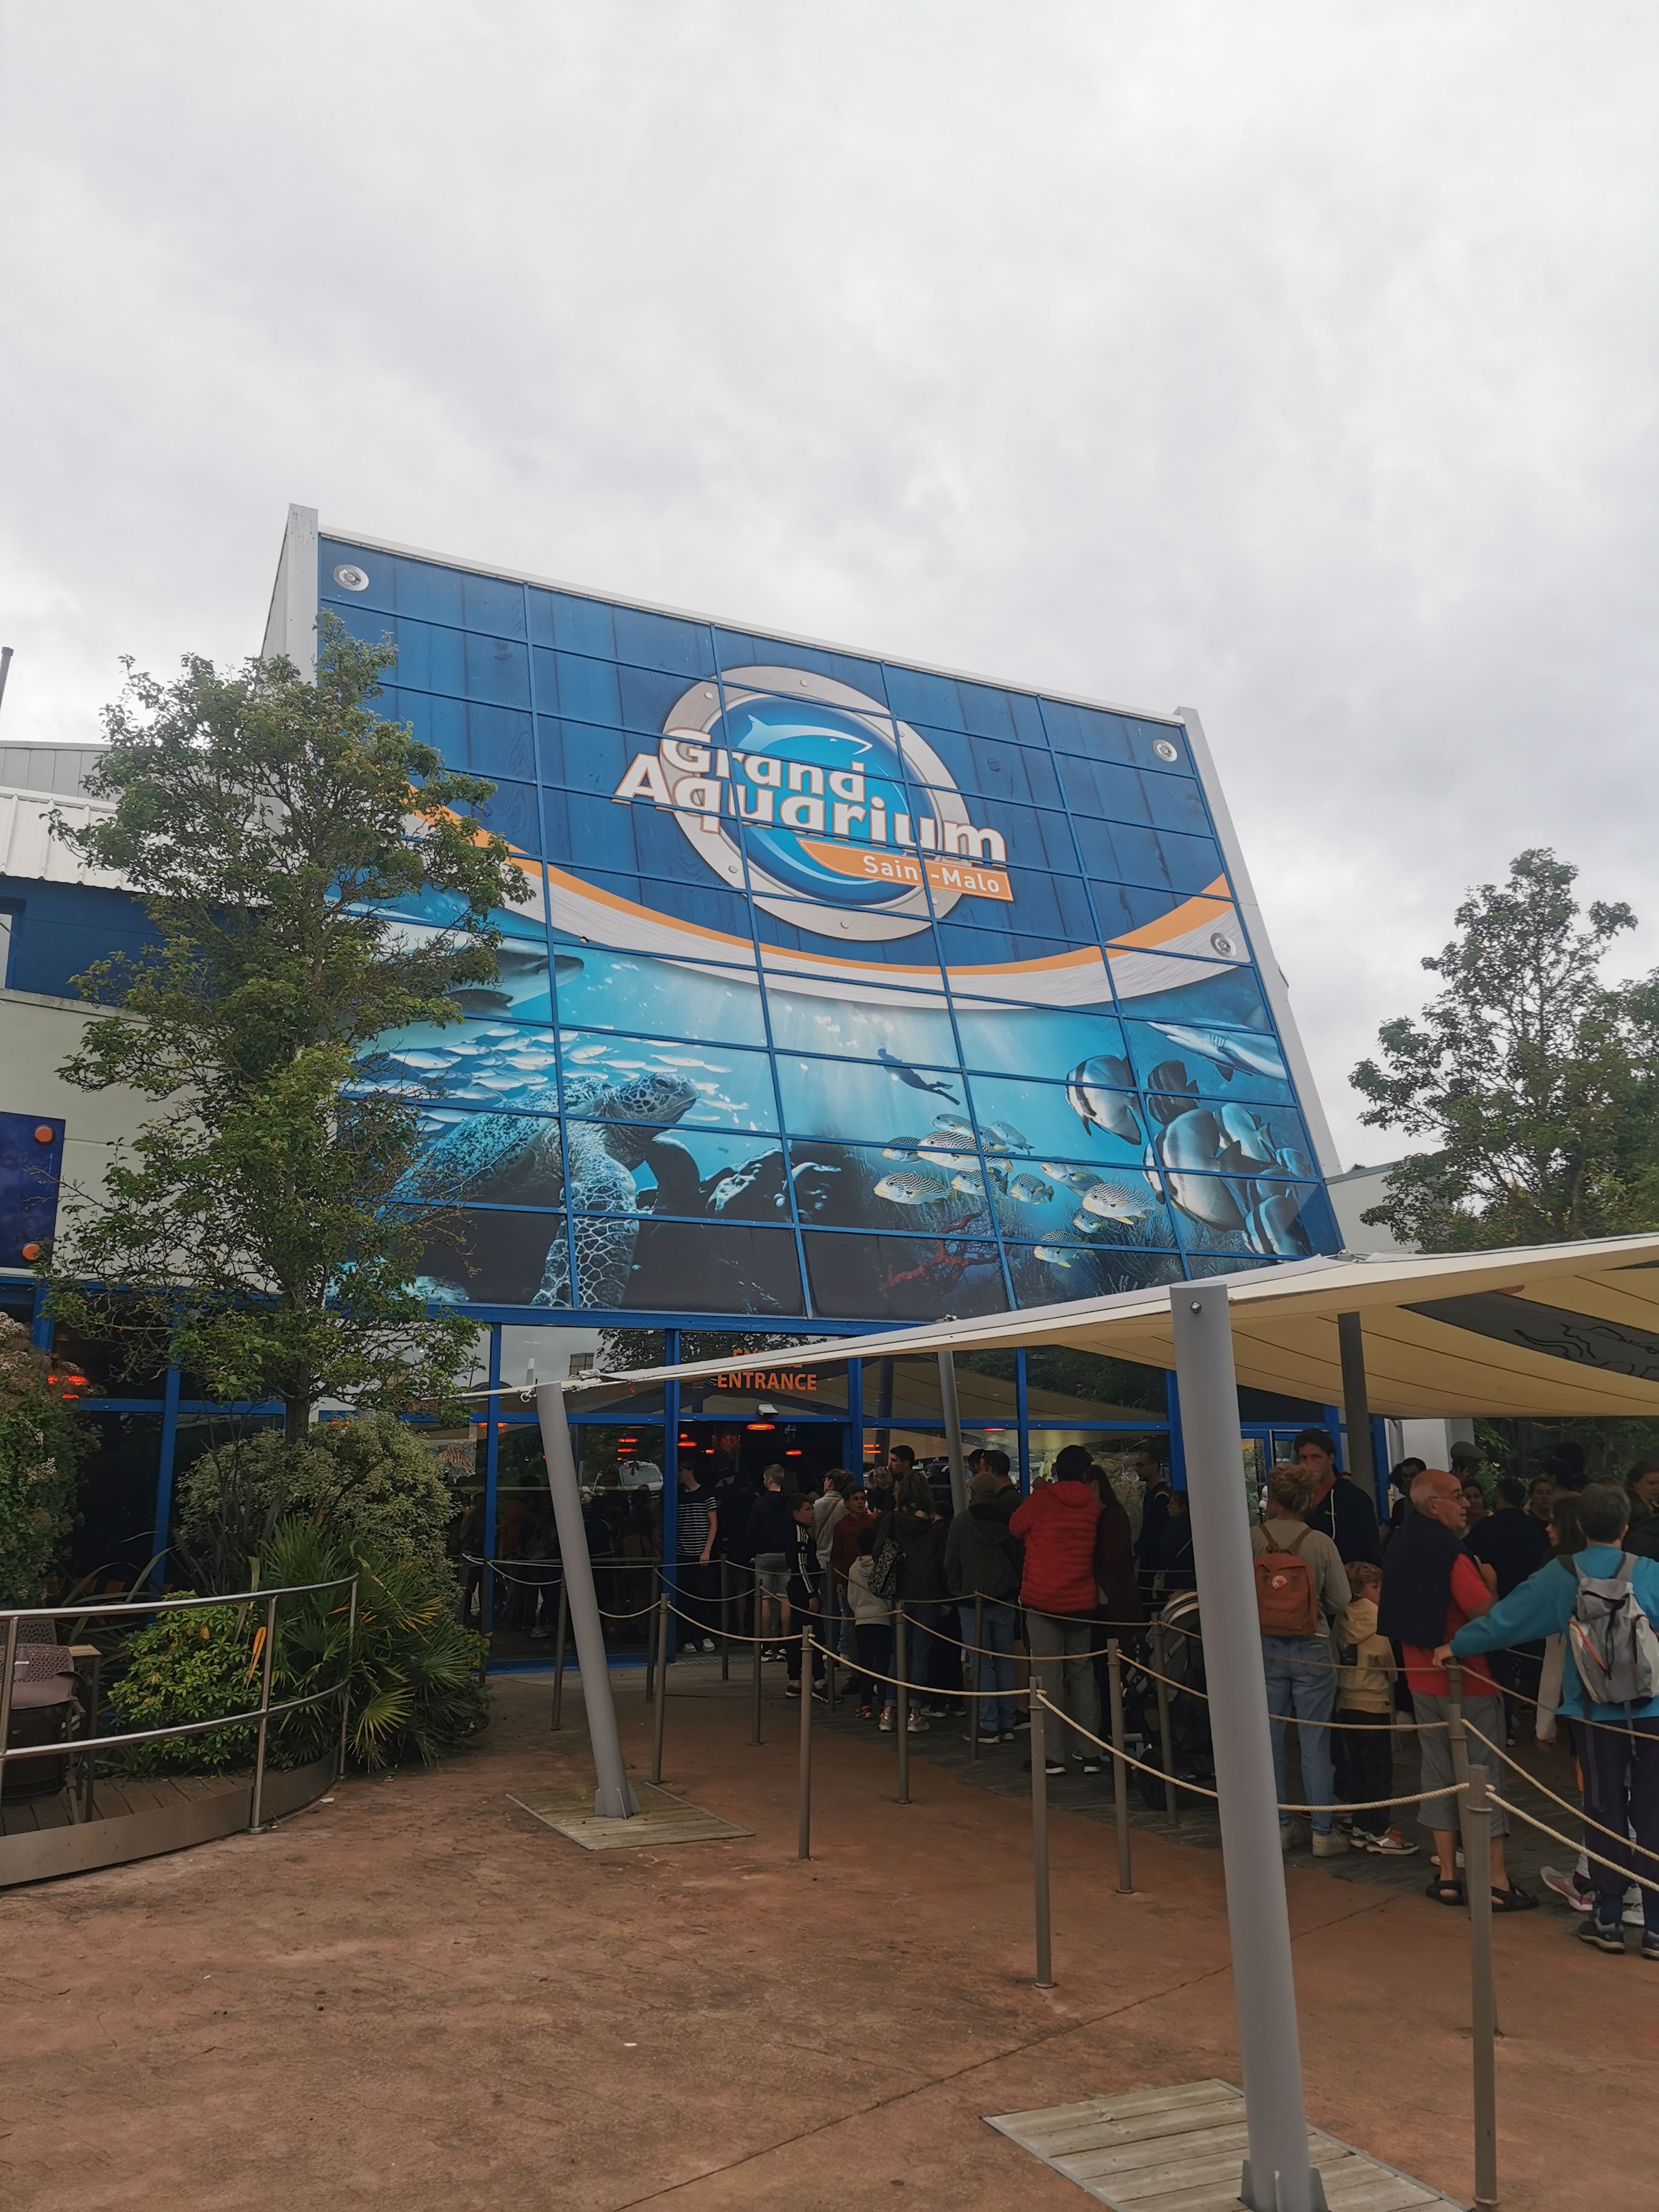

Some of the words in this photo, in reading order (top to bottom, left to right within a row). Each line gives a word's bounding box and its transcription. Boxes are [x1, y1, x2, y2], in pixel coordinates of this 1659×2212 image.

[660, 727, 866, 803] Grand
[611, 752, 1007, 868] Aquarium
[863, 855, 1000, 893] Sain-Malo
[717, 1372, 817, 1391] ENTRANCE
